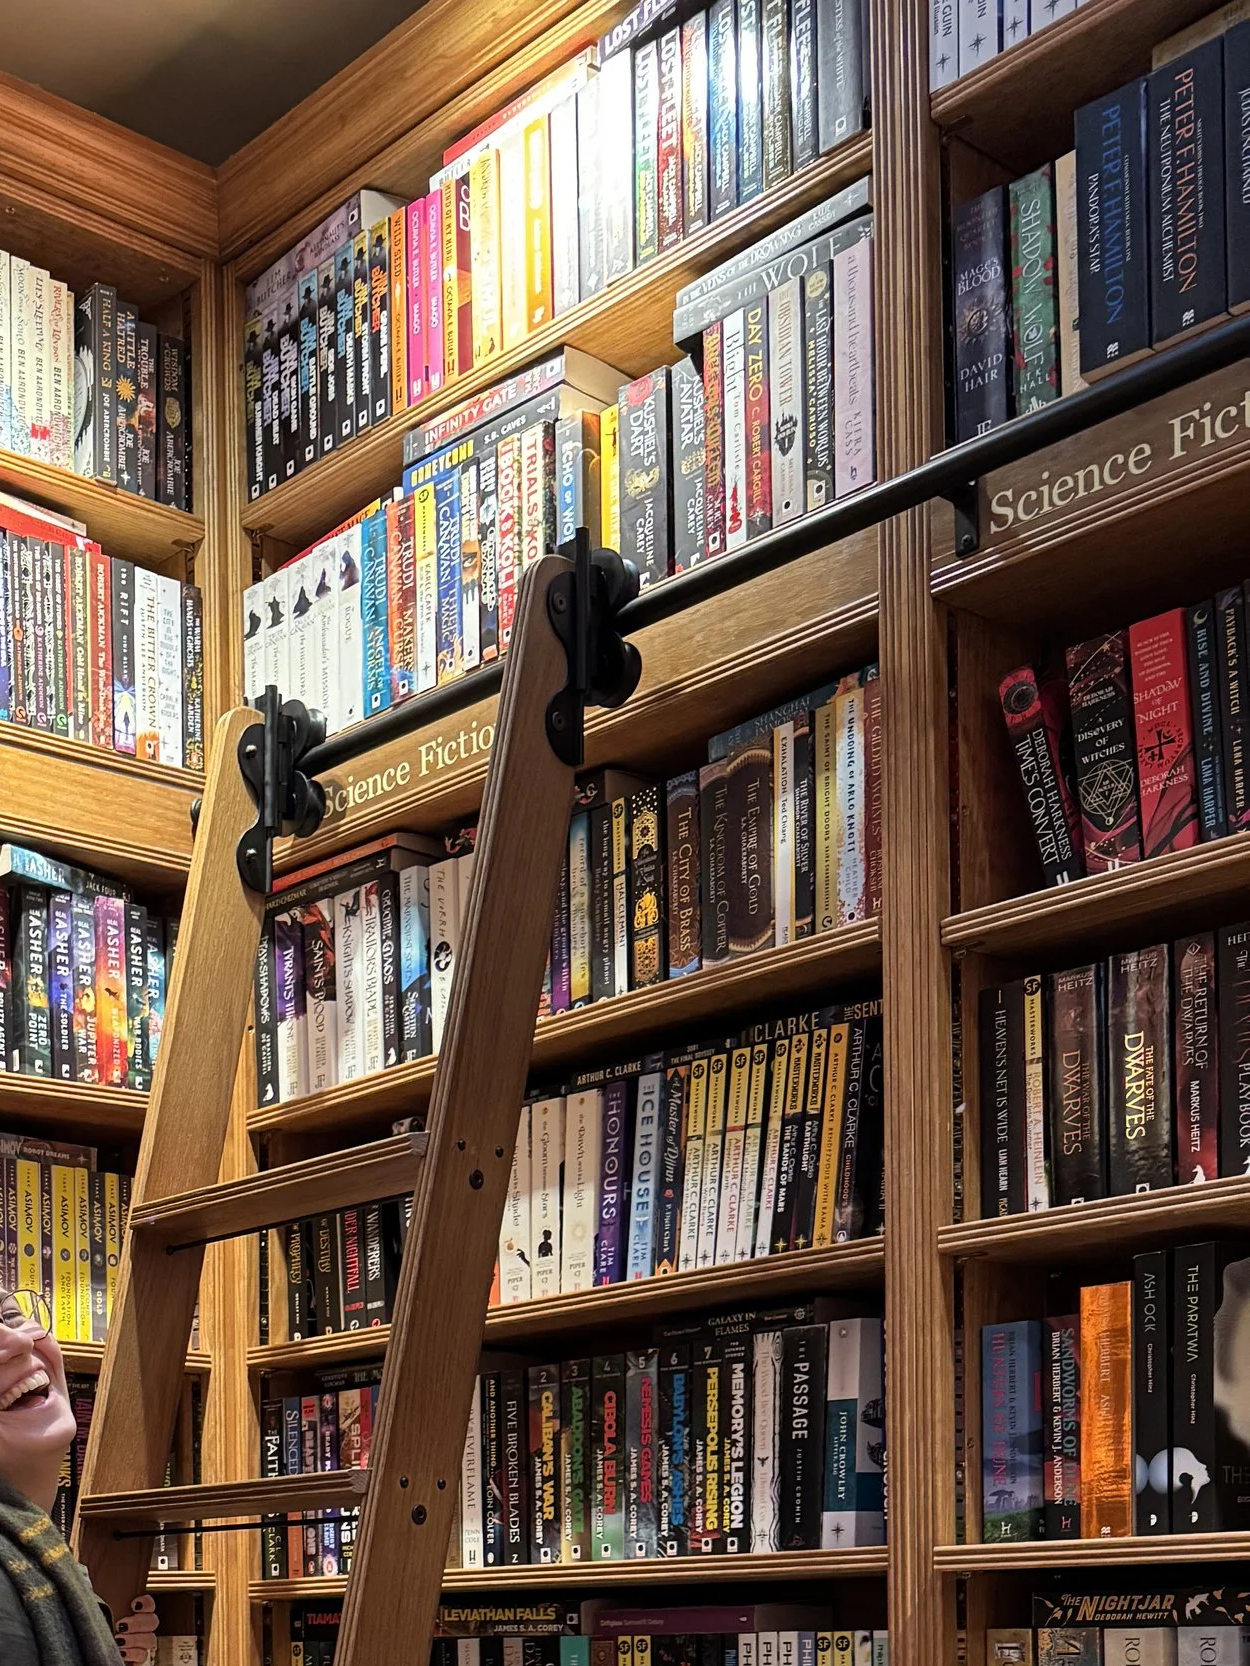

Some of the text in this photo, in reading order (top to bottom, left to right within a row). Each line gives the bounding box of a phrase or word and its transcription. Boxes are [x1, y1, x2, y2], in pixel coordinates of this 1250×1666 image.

[1020, 198, 1044, 374] SHADOW WOLF
[747, 306, 762, 402] DAY ZERO
[424, 382, 518, 443] INFINITY GATE
[629, 409, 644, 458] DART
[990, 442, 1152, 536] Science
[1136, 701, 1179, 724] NIGHT
[418, 721, 497, 778] Fictio
[1027, 786, 1060, 865] CONVERT
[27, 913, 43, 974] ASHER
[754, 1011, 820, 1042] CLARKE
[1124, 1030, 1145, 1140] DWARVES
[602, 1101, 620, 1221] HONOURS
[1187, 1265, 1199, 1292] THE
[506, 1400, 521, 1544] FIVE BROKEN BLADES
[444, 1607, 556, 1622] LEVIATHAN FALLS
[1076, 1594, 1175, 1621] NIGHTJAR
